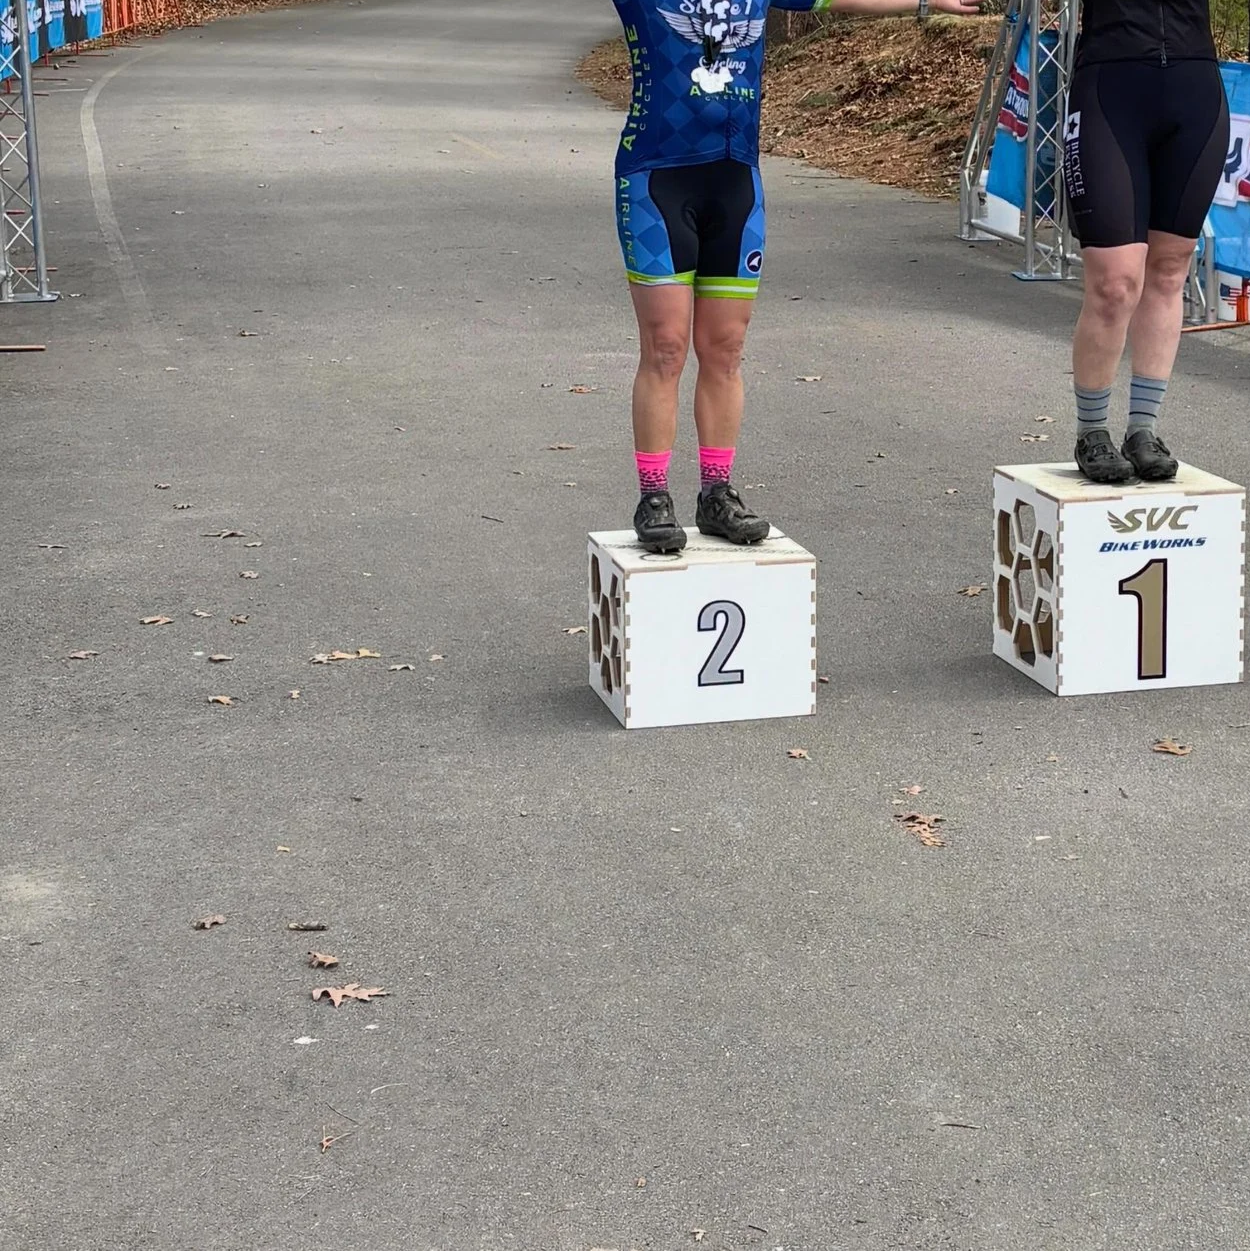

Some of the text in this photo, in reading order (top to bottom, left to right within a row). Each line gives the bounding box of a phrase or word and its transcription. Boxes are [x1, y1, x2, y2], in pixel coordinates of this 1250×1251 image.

[622, 24, 642, 151] AIRLINE
[640, 47, 652, 130] CYCLES
[690, 85, 755, 99] ALINE
[1071, 141, 1085, 197] BICYCLE
[619, 177, 637, 266] AIRLINE
[1112, 505, 1199, 534] SVC
[697, 600, 746, 687] 2
[1118, 558, 1168, 680] 1
